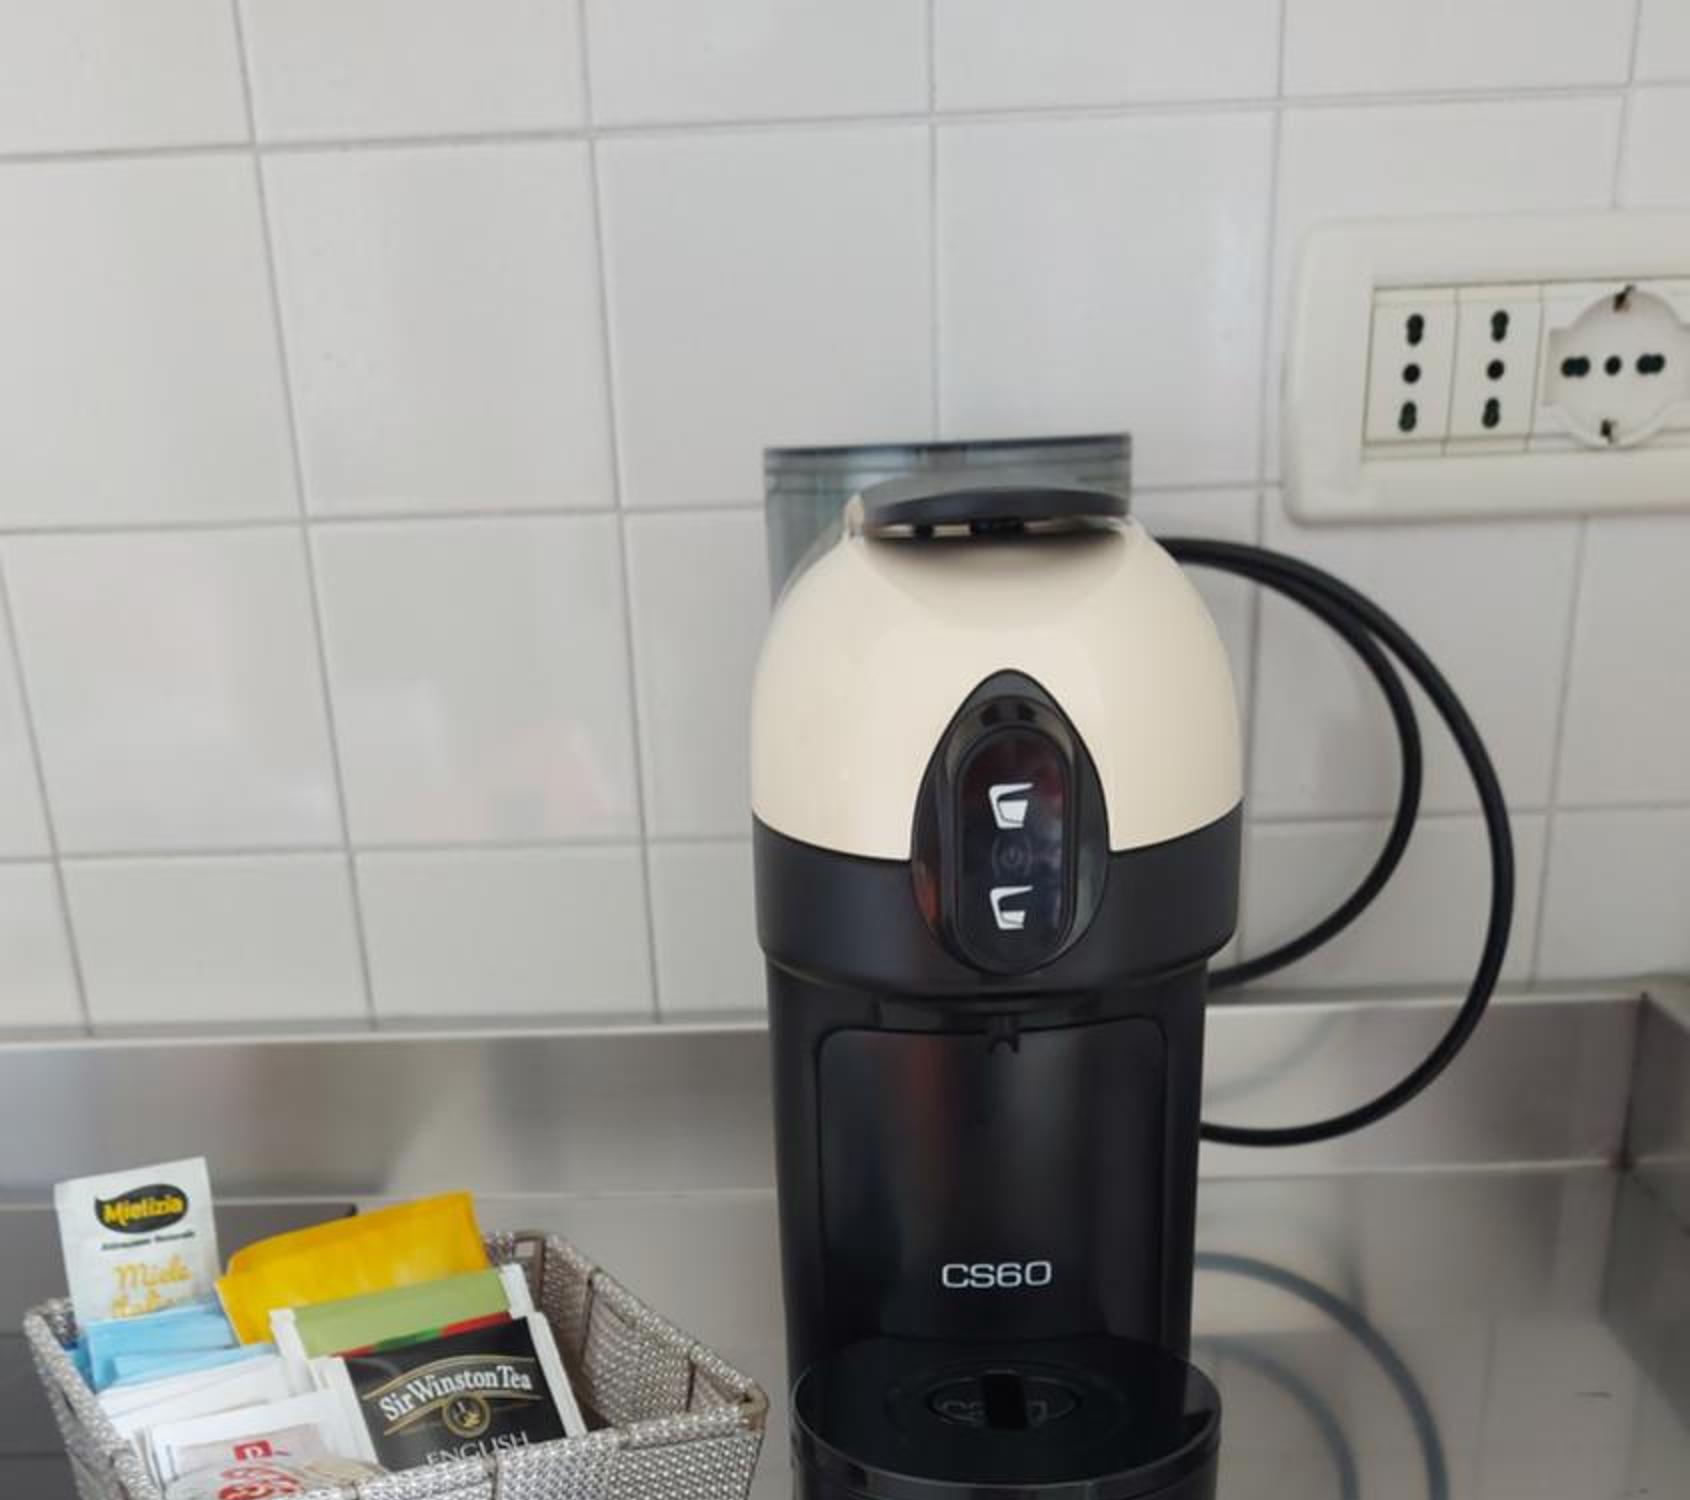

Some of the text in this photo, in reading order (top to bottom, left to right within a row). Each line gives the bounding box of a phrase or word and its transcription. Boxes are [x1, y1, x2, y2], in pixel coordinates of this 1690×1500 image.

[103, 1194, 184, 1227] Mielizia
[941, 1260, 1053, 1289] CS60
[379, 1364, 533, 1422] Sir Winston Tea
[426, 1430, 529, 1465] ENGLISH
